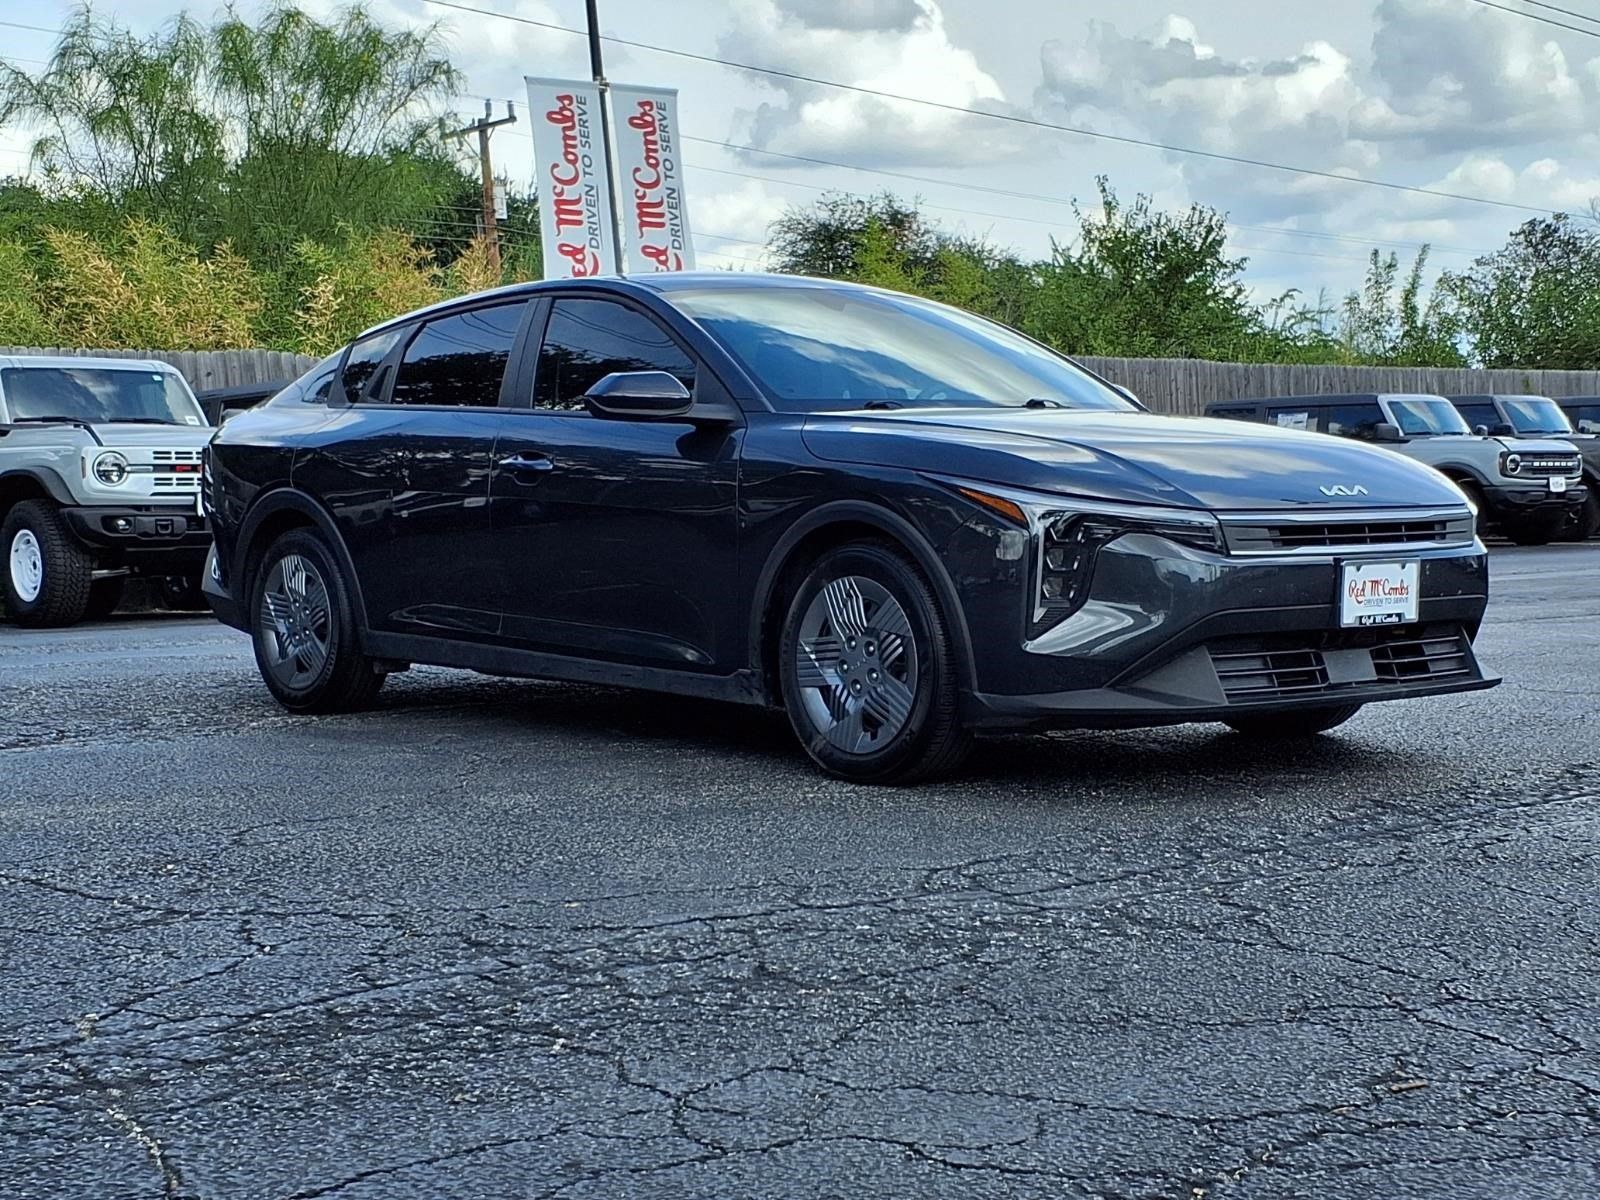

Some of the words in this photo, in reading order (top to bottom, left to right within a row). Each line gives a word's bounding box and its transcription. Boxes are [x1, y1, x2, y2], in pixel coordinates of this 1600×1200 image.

[576, 95, 591, 150] SERVE
[656, 101, 671, 154] SERVE
[546, 94, 585, 237] McCombs
[581, 154, 593, 178] TO
[628, 100, 666, 239] McCombs
[662, 158, 674, 181] TO
[584, 184, 600, 250] DRIVEN
[666, 187, 682, 251] DRIVEN
[558, 243, 599, 278] ed
[1320, 485, 1368, 496] KIA
[1348, 579, 1367, 604] Red
[1368, 578, 1409, 597] McCombs
[1364, 598, 1383, 606] DRIVEN
[1393, 596, 1409, 604] SERVE
